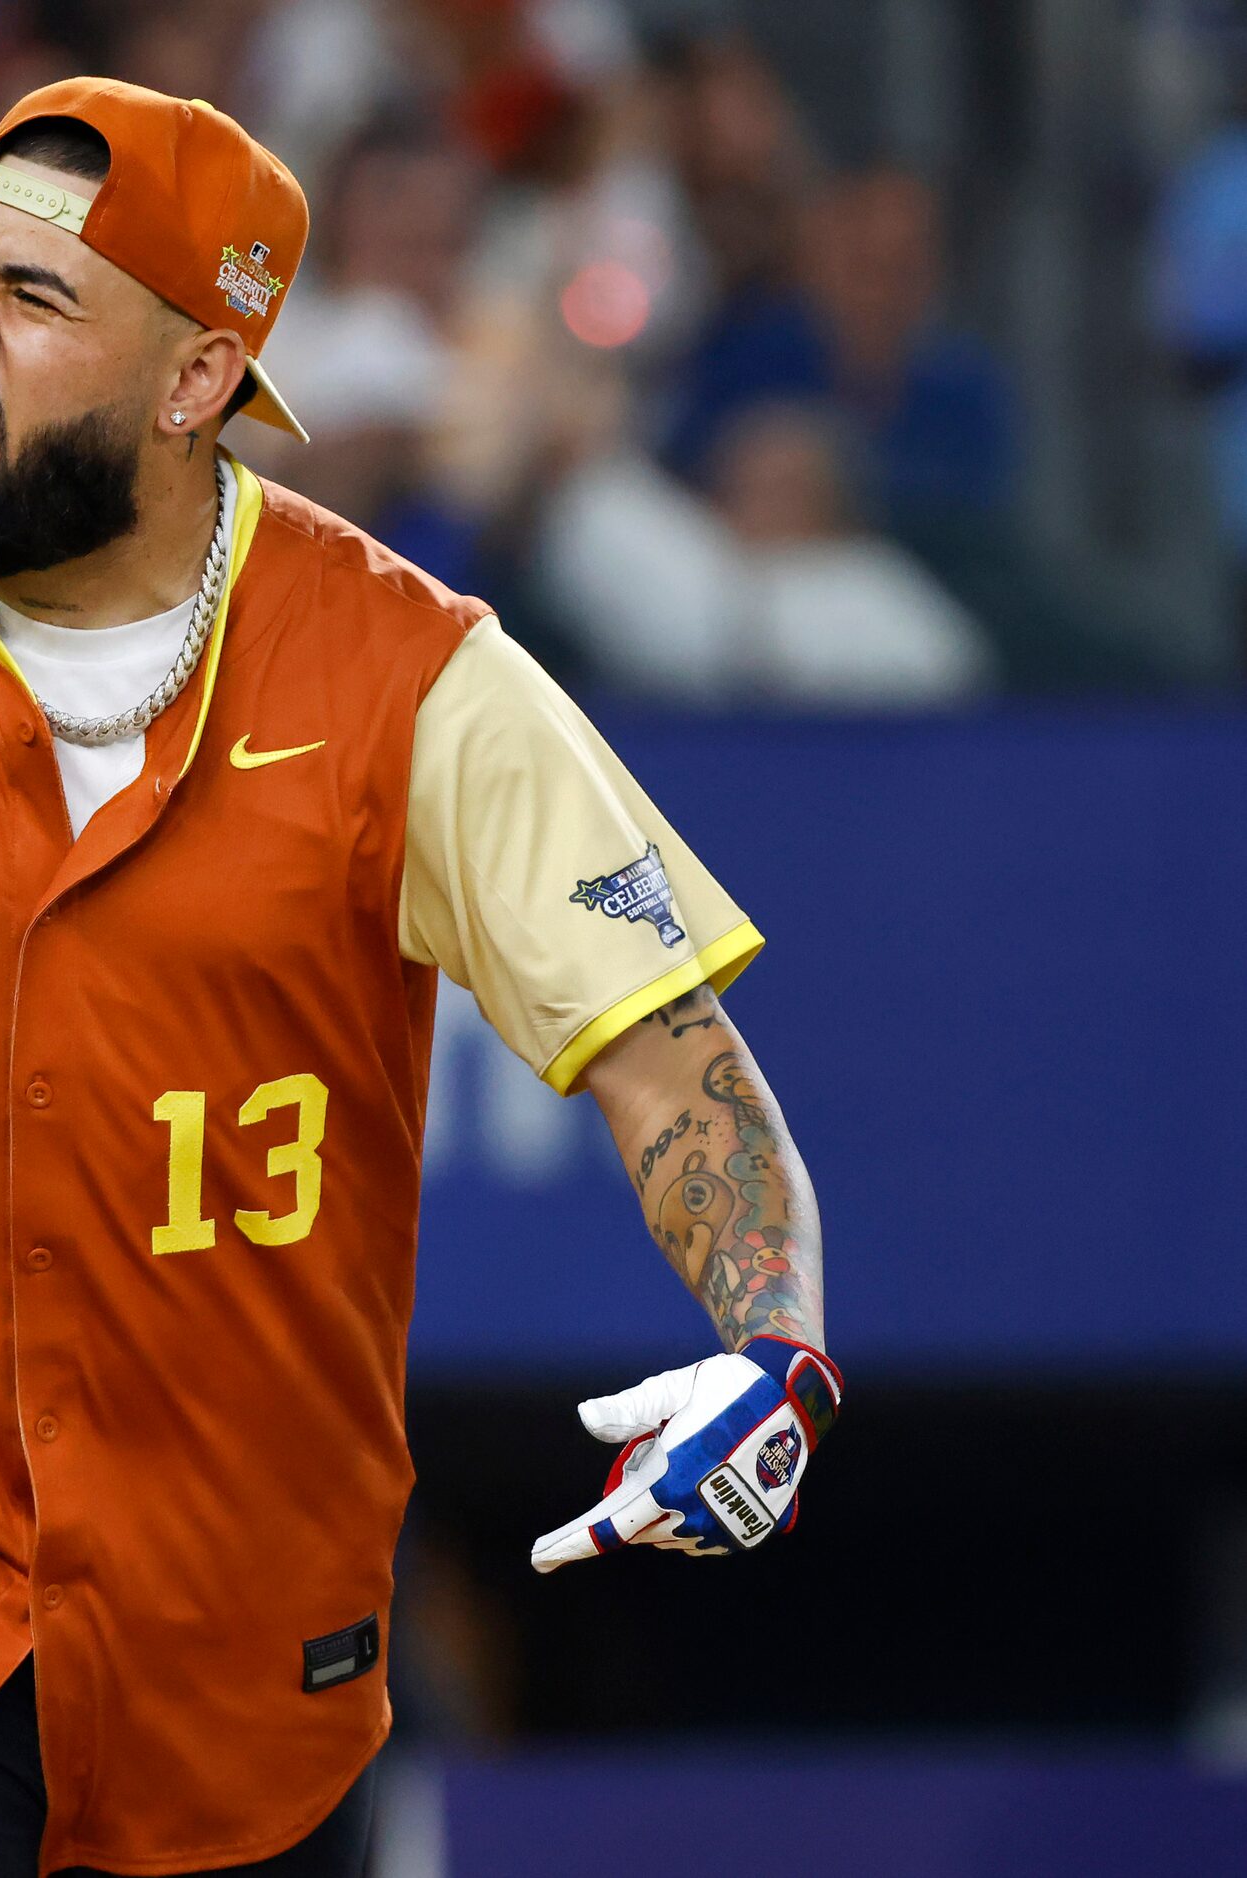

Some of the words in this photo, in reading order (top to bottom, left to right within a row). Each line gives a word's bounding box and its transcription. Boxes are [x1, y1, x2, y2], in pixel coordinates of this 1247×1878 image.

[219, 262, 273, 305] CELEBRITY
[626, 896, 660, 919] SOFTBALL
[152, 1073, 330, 1256] 13
[770, 1441, 790, 1469] GAME
[709, 1473, 772, 1541] franklin
